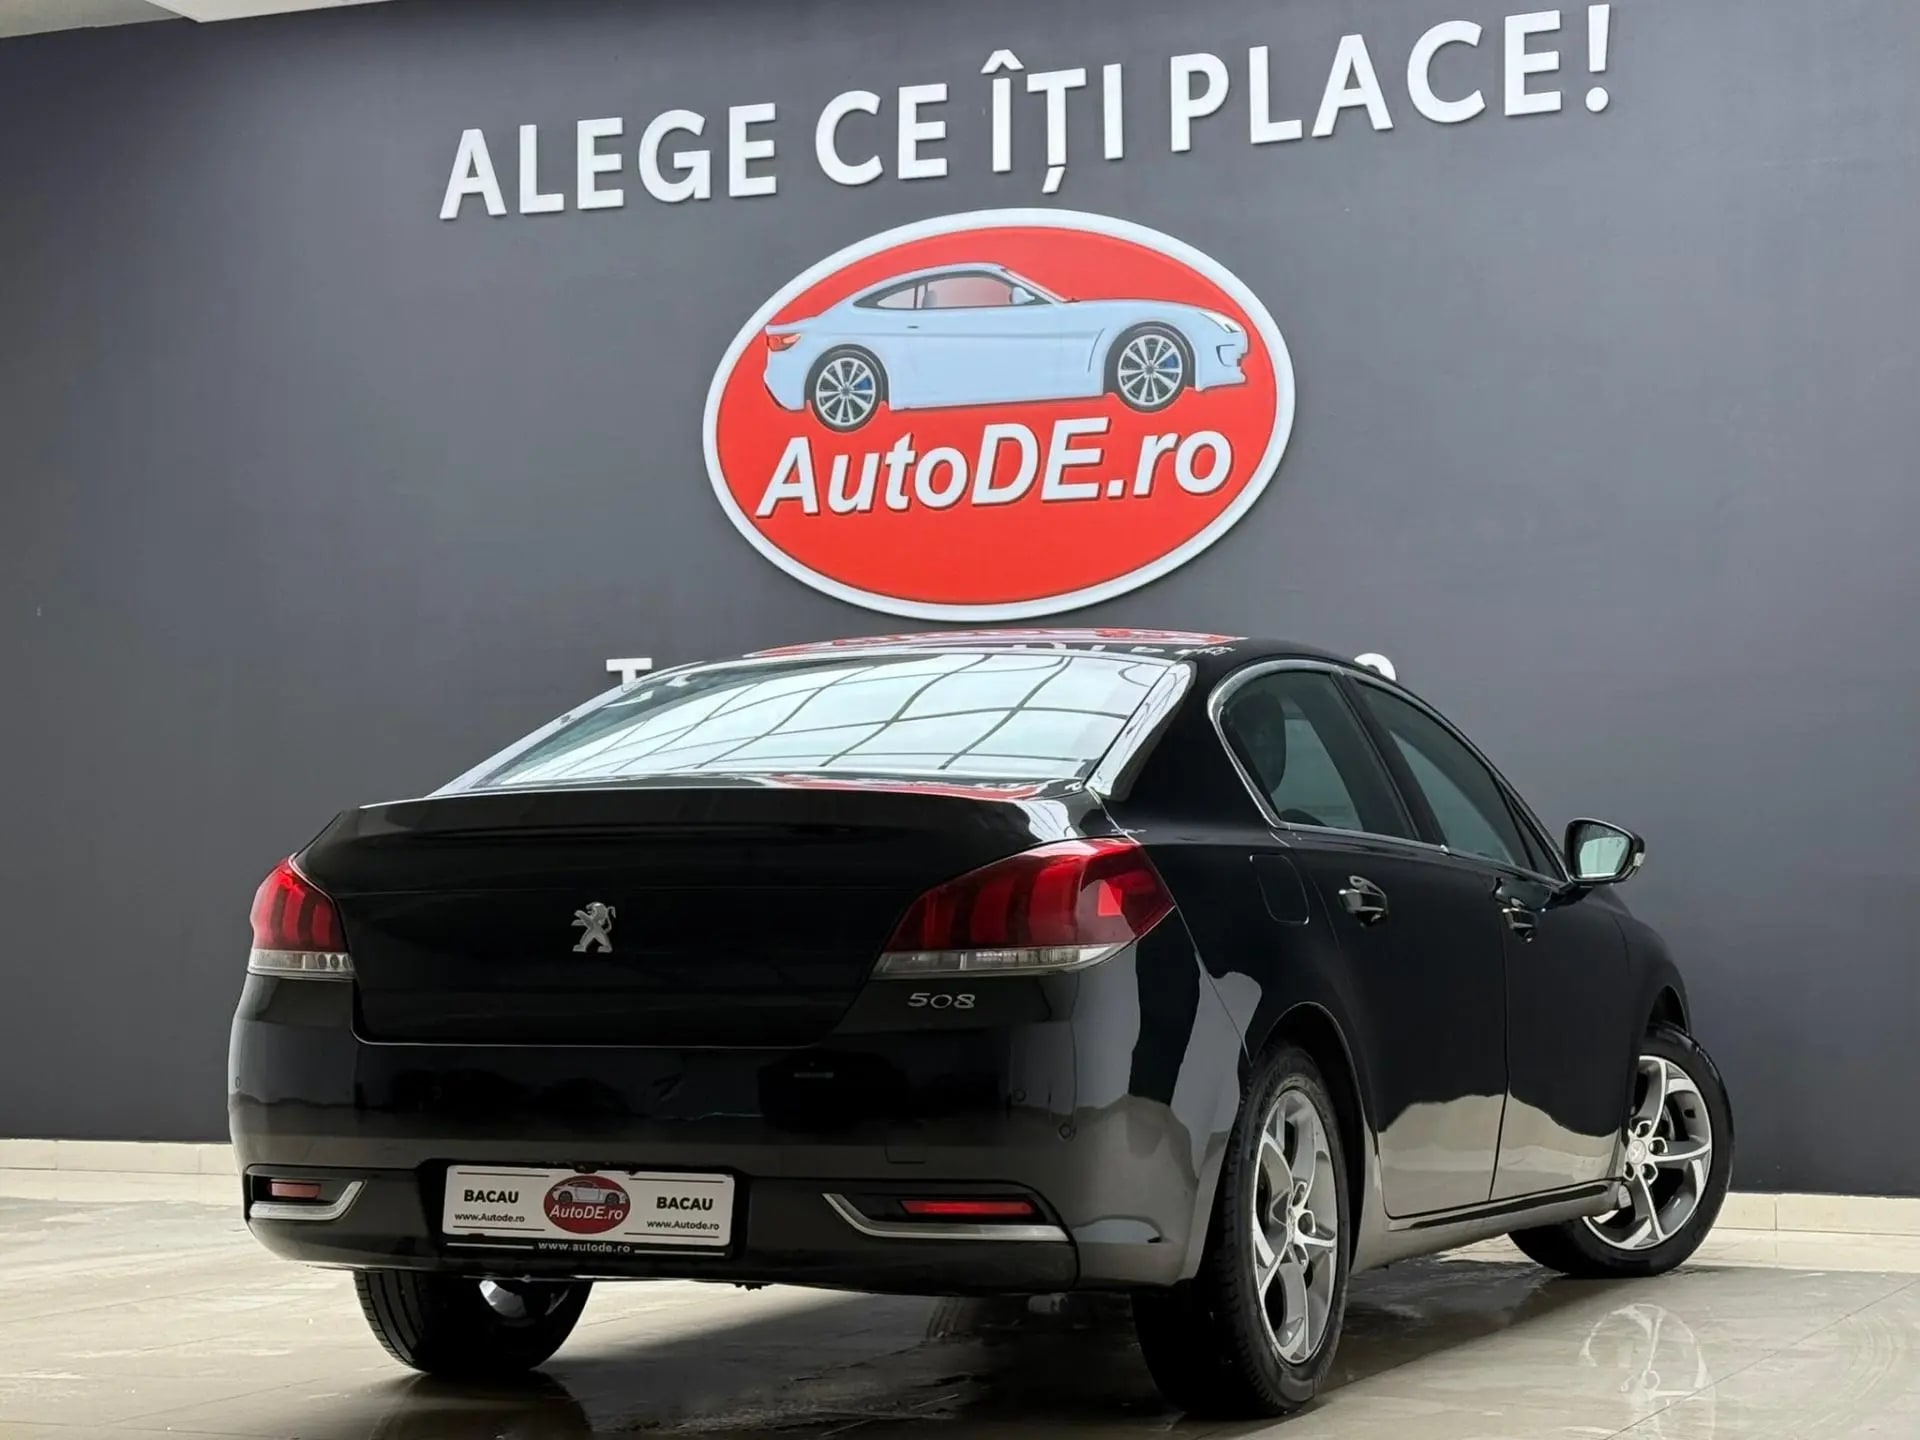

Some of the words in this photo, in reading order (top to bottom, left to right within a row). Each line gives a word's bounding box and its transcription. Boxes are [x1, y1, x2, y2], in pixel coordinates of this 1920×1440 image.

[439, 103, 777, 220] ALEGE
[815, 83, 949, 187] CE
[980, 48, 1124, 194] ÎȚI
[1170, 4, 1611, 153] PLACE!
[755, 416, 1234, 519] AutoDE.ro
[907, 992, 976, 1009] 508
[463, 1188, 519, 1204] BACAU
[656, 1196, 714, 1211] BACAU
[454, 1213, 526, 1223] www.Autode.ro
[549, 1204, 624, 1220] AutoDE.ro
[646, 1220, 720, 1231] www.Autode.ro
[538, 1241, 631, 1253] www.autode.ro
